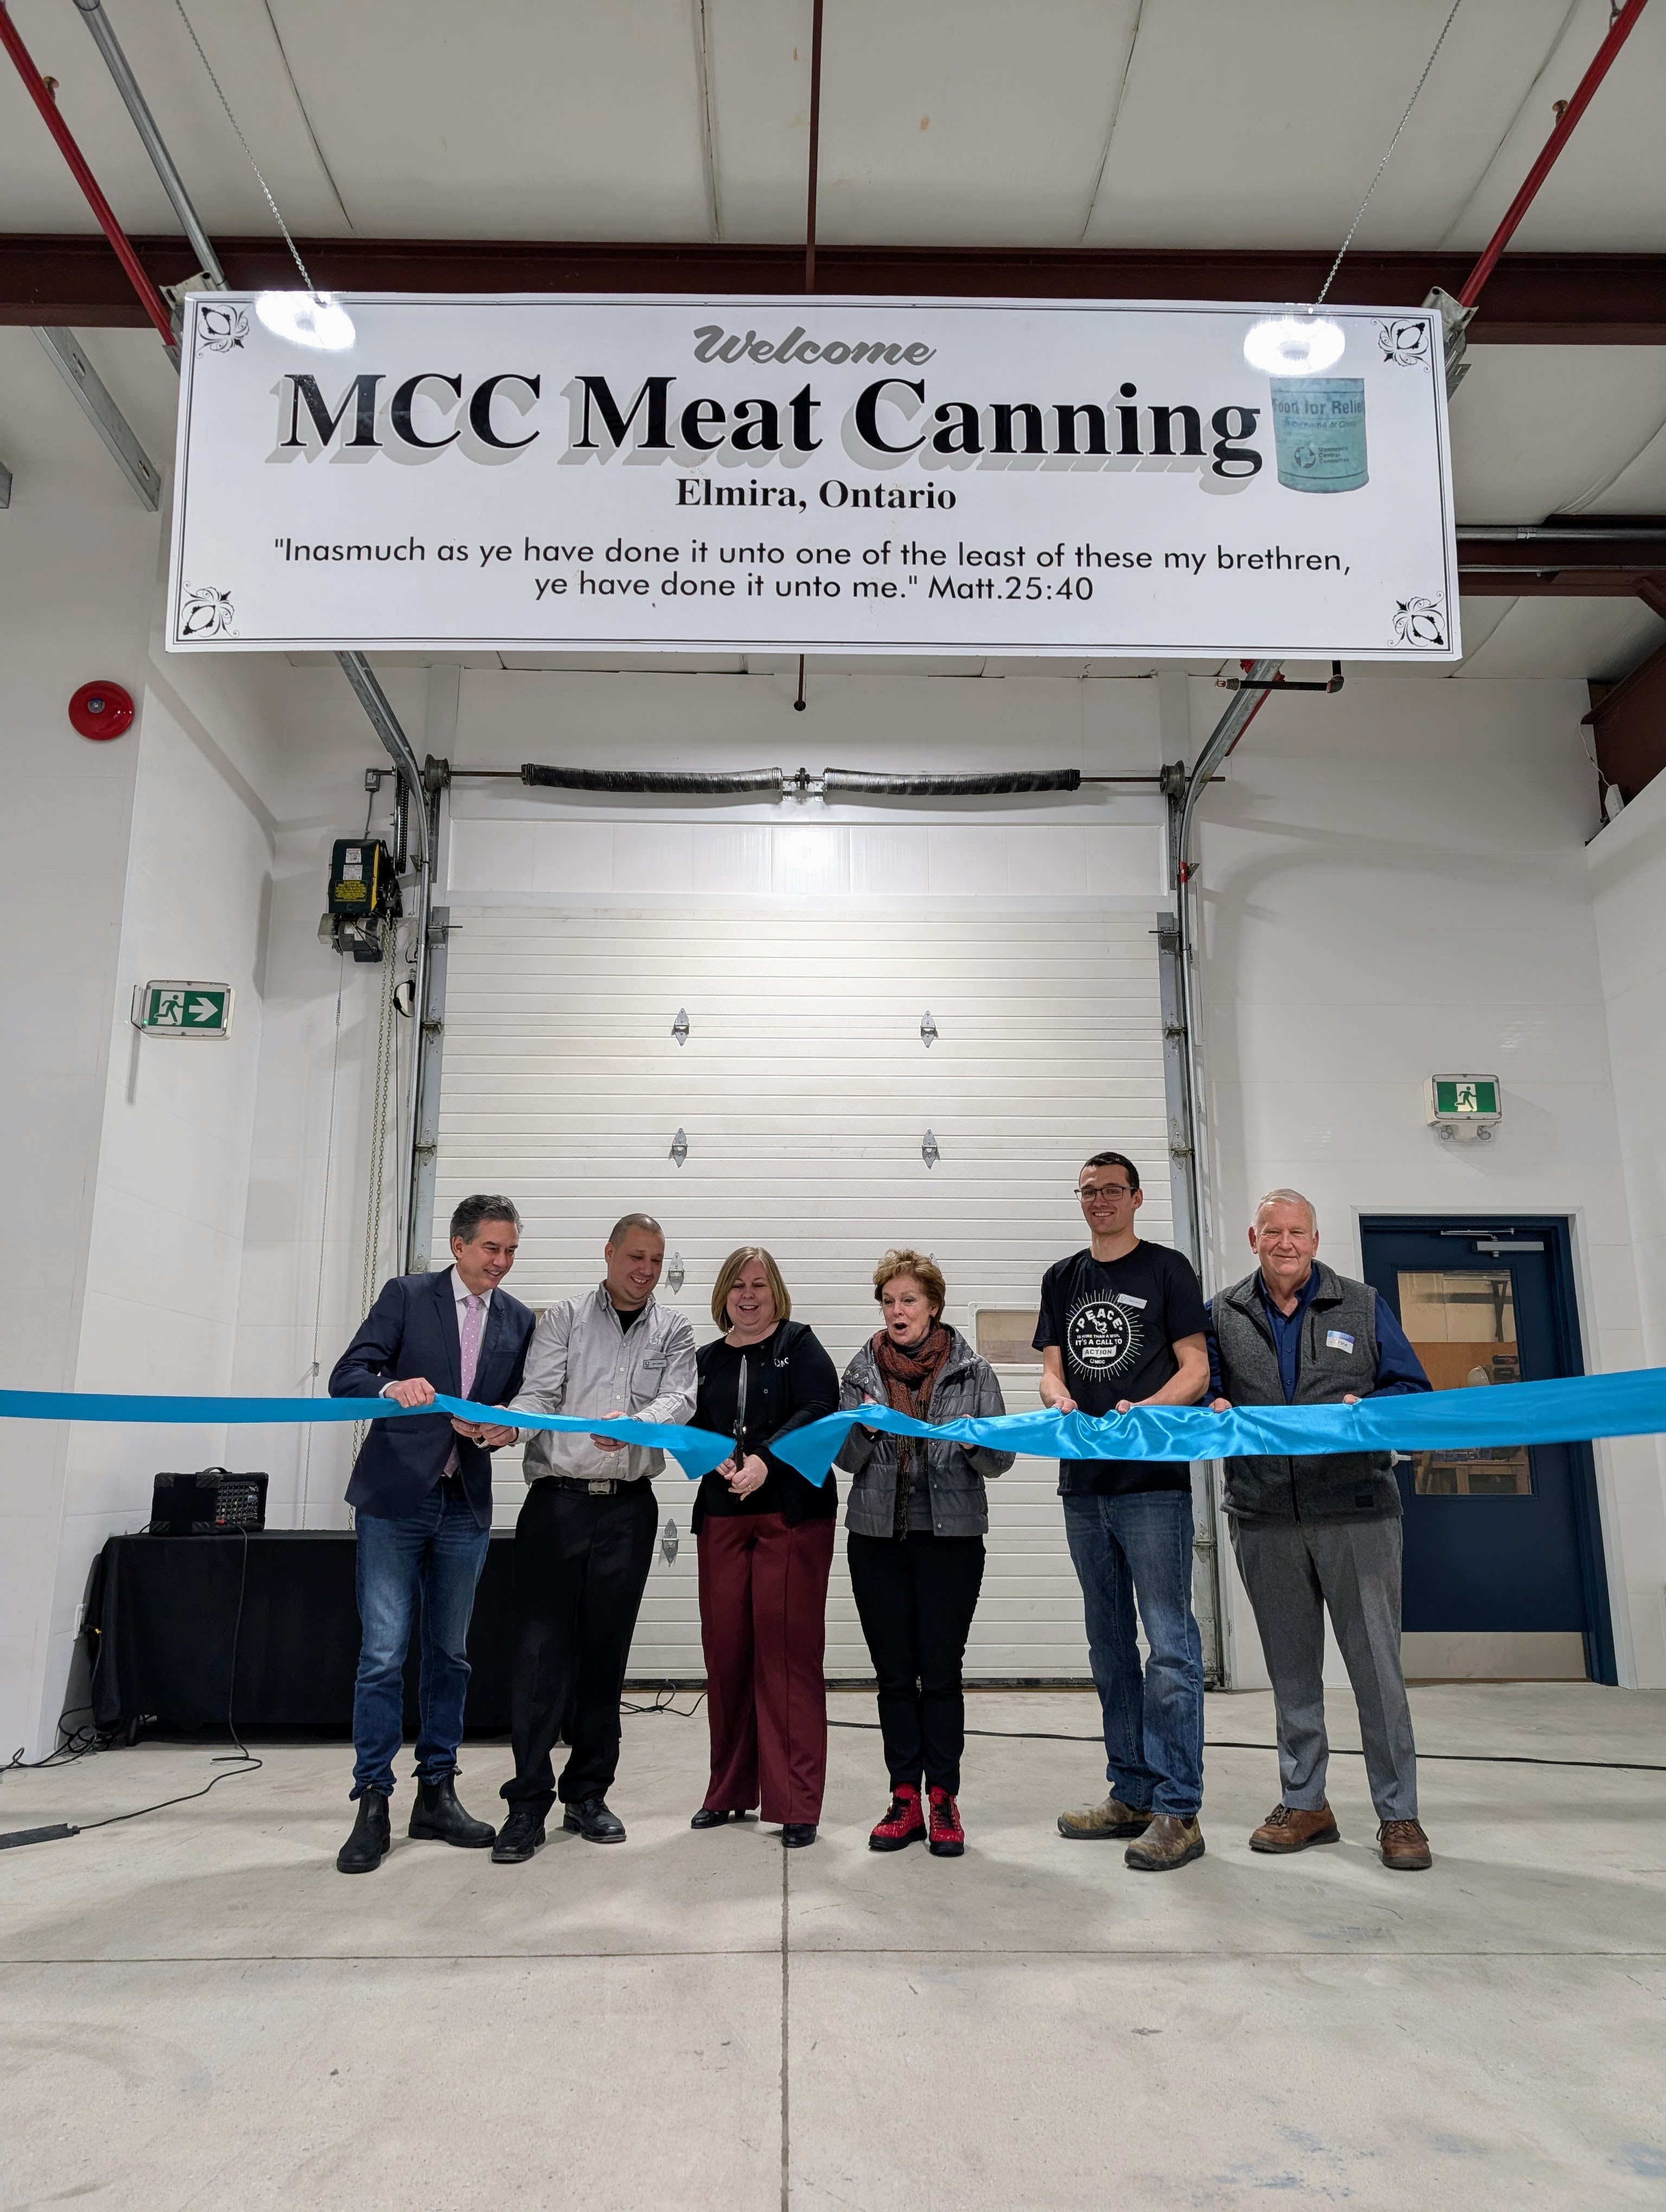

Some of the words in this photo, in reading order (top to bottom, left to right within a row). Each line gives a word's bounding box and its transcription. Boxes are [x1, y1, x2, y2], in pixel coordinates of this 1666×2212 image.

[693, 325, 937, 366] Welcome
[279, 373, 541, 449] MCC
[572, 376, 823, 452] Meat
[854, 378, 1263, 478] Canning
[677, 479, 807, 513] Elmira,
[819, 480, 956, 510] Ontario
[275, 536, 425, 562] "Inasmuch
[437, 545, 469, 562] as
[479, 545, 512, 568] ye
[524, 537, 594, 562] have
[605, 538, 680, 563] done
[692, 539, 708, 563] it
[720, 543, 785, 564] unto
[796, 548, 851, 564] one
[862, 540, 892, 565] of
[900, 541, 946, 566] the
[959, 542, 1026, 567] least
[1036, 542, 1065, 568] of
[1074, 543, 1152, 568] these
[1164, 552, 1207, 575] my
[1218, 544, 1350, 576] brethren,
[535, 578, 567, 601] ye
[580, 570, 650, 595] have
[661, 571, 735, 596] done
[748, 573, 764, 596] it
[776, 576, 841, 597] unto
[853, 575, 917, 598] me."
[928, 575, 1093, 600] Matt.25:40
[1077, 1308, 1124, 1329] PEACE
